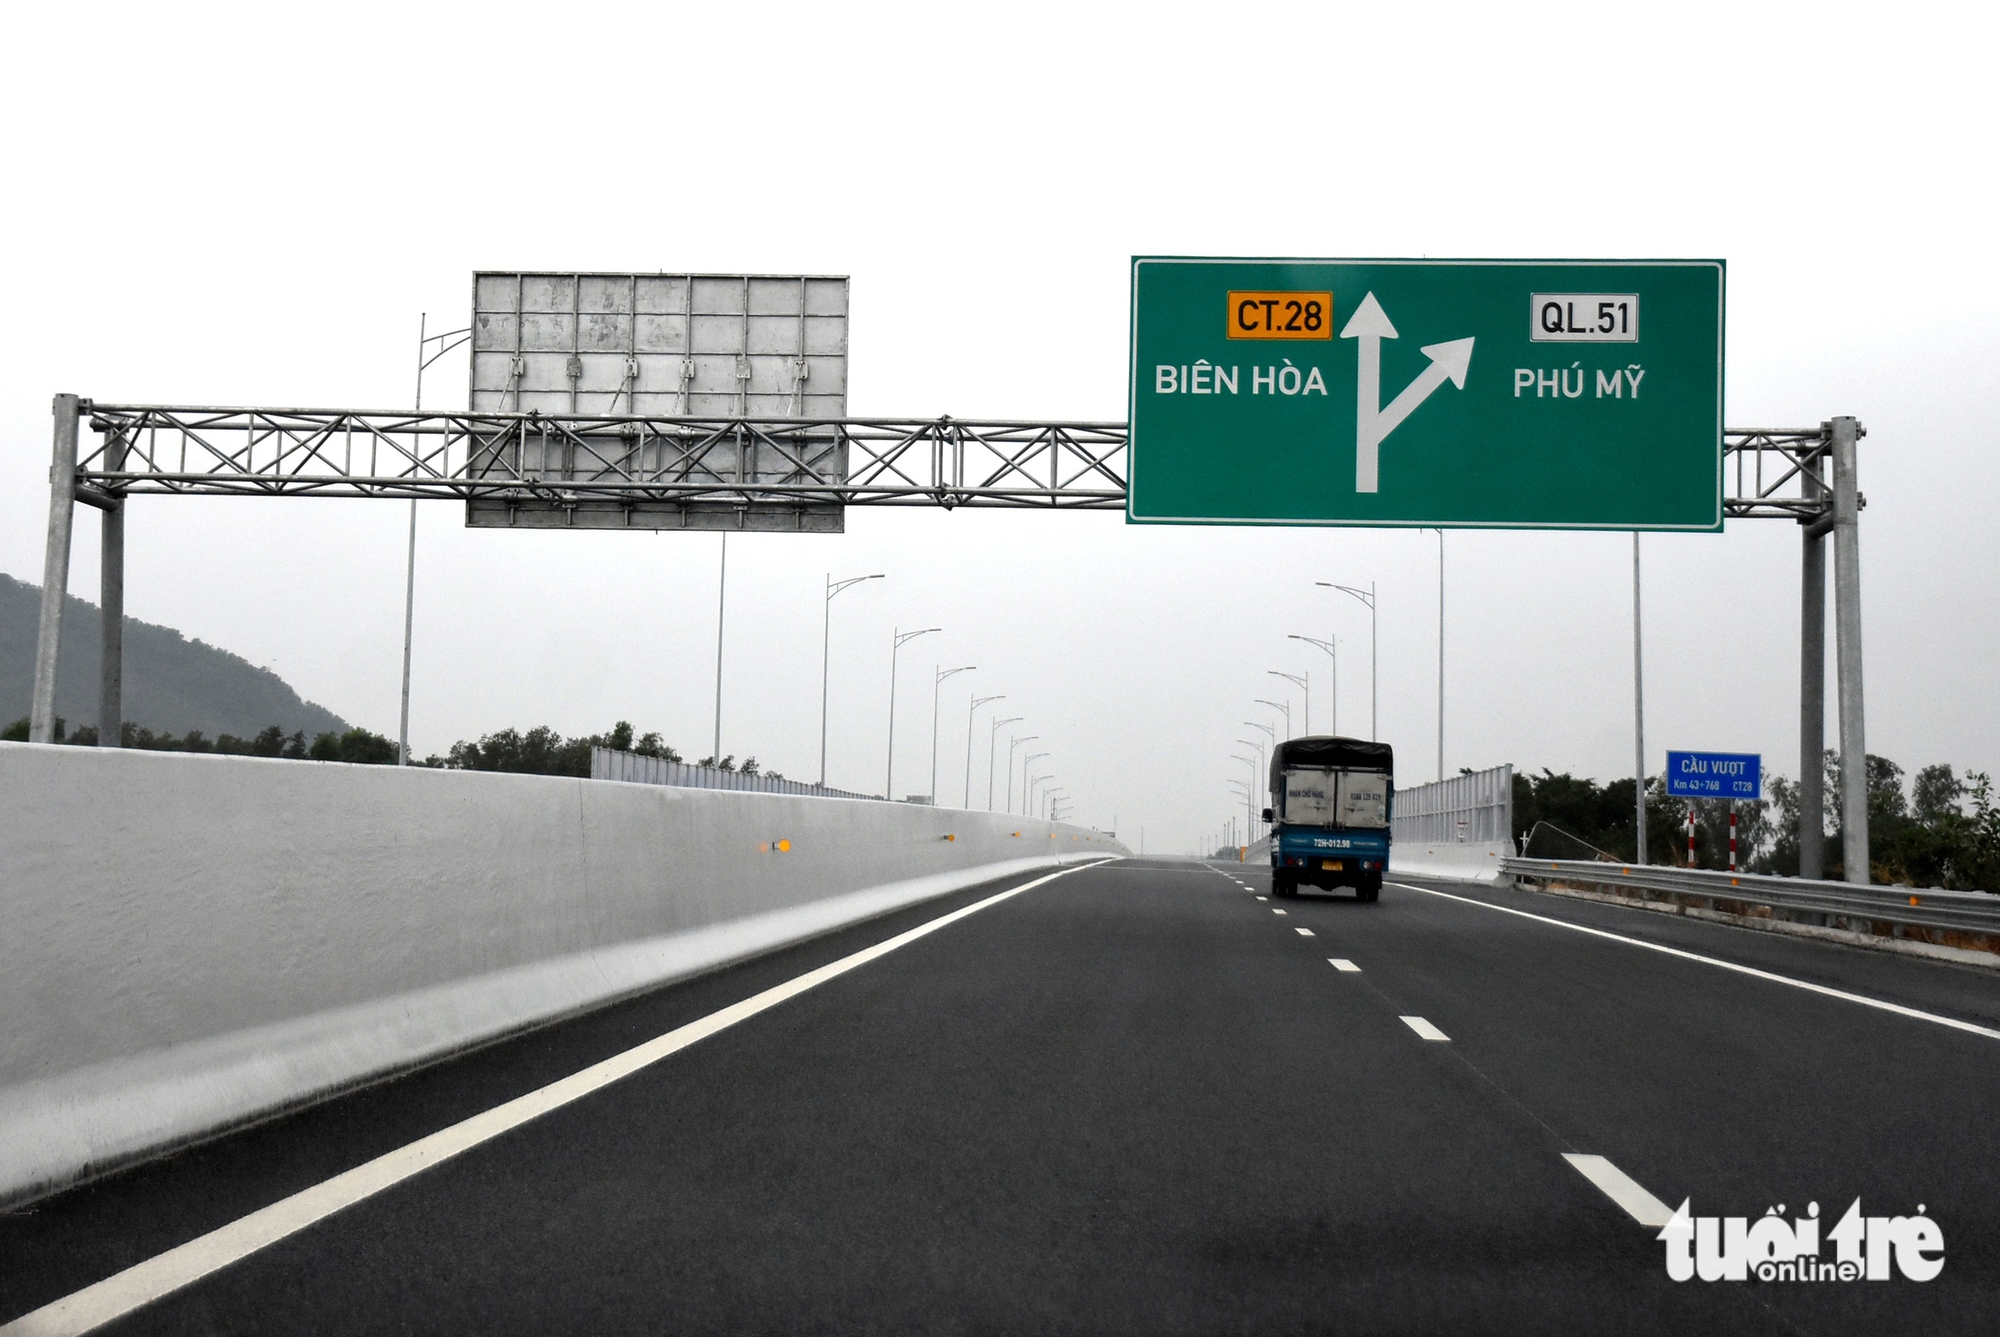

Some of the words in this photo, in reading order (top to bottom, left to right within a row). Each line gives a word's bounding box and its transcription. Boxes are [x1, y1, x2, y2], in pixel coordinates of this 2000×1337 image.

[1237, 300, 1323, 332] CT.28
[1540, 301, 1630, 335] QL.51
[1155, 358, 1239, 395] BIÊN
[1252, 358, 1328, 396] HÒA
[1514, 361, 1583, 398] PHÚ
[1595, 364, 1646, 399] MỸ
[1681, 754, 1707, 774] CẦU
[1711, 760, 1746, 777] VƯỢT
[1673, 778, 1687, 789] Km
[1689, 779, 1720, 791] 43+768
[1732, 780, 1753, 792] CT28
[1313, 838, 1351, 848] 72H-012.98
